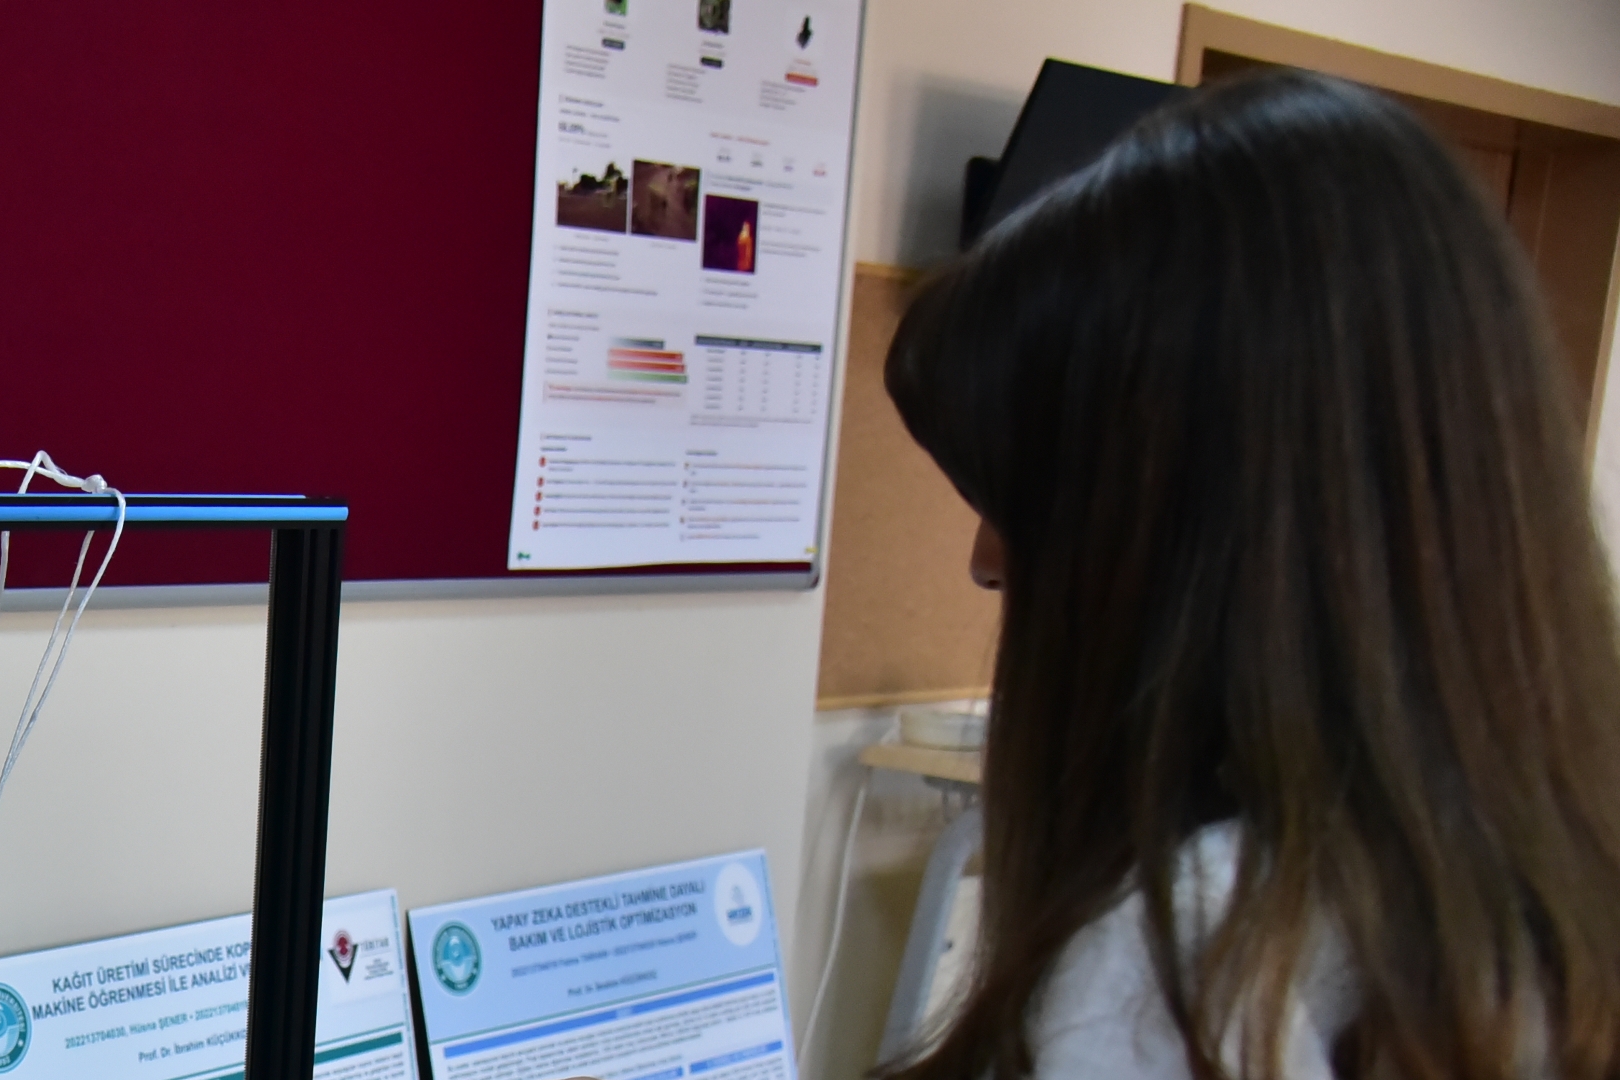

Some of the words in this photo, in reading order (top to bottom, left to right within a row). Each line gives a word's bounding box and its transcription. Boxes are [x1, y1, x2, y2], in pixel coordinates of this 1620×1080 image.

[491, 913, 528, 931] YAPAY
[532, 905, 563, 925] ZEKA
[508, 932, 547, 951] BAKIM
[549, 926, 566, 943] VE
[52, 971, 93, 994] KAĞIT
[97, 957, 150, 985] ÜRETİMİ
[152, 947, 223, 974] SÜRECİNDE
[226, 941, 251, 960] KOP
[31, 996, 86, 1021] MAKİNE
[88, 982, 166, 1009] ÖĞRENMESİ
[169, 975, 188, 994] İLE
[191, 965, 238, 988] ANALİZİ
